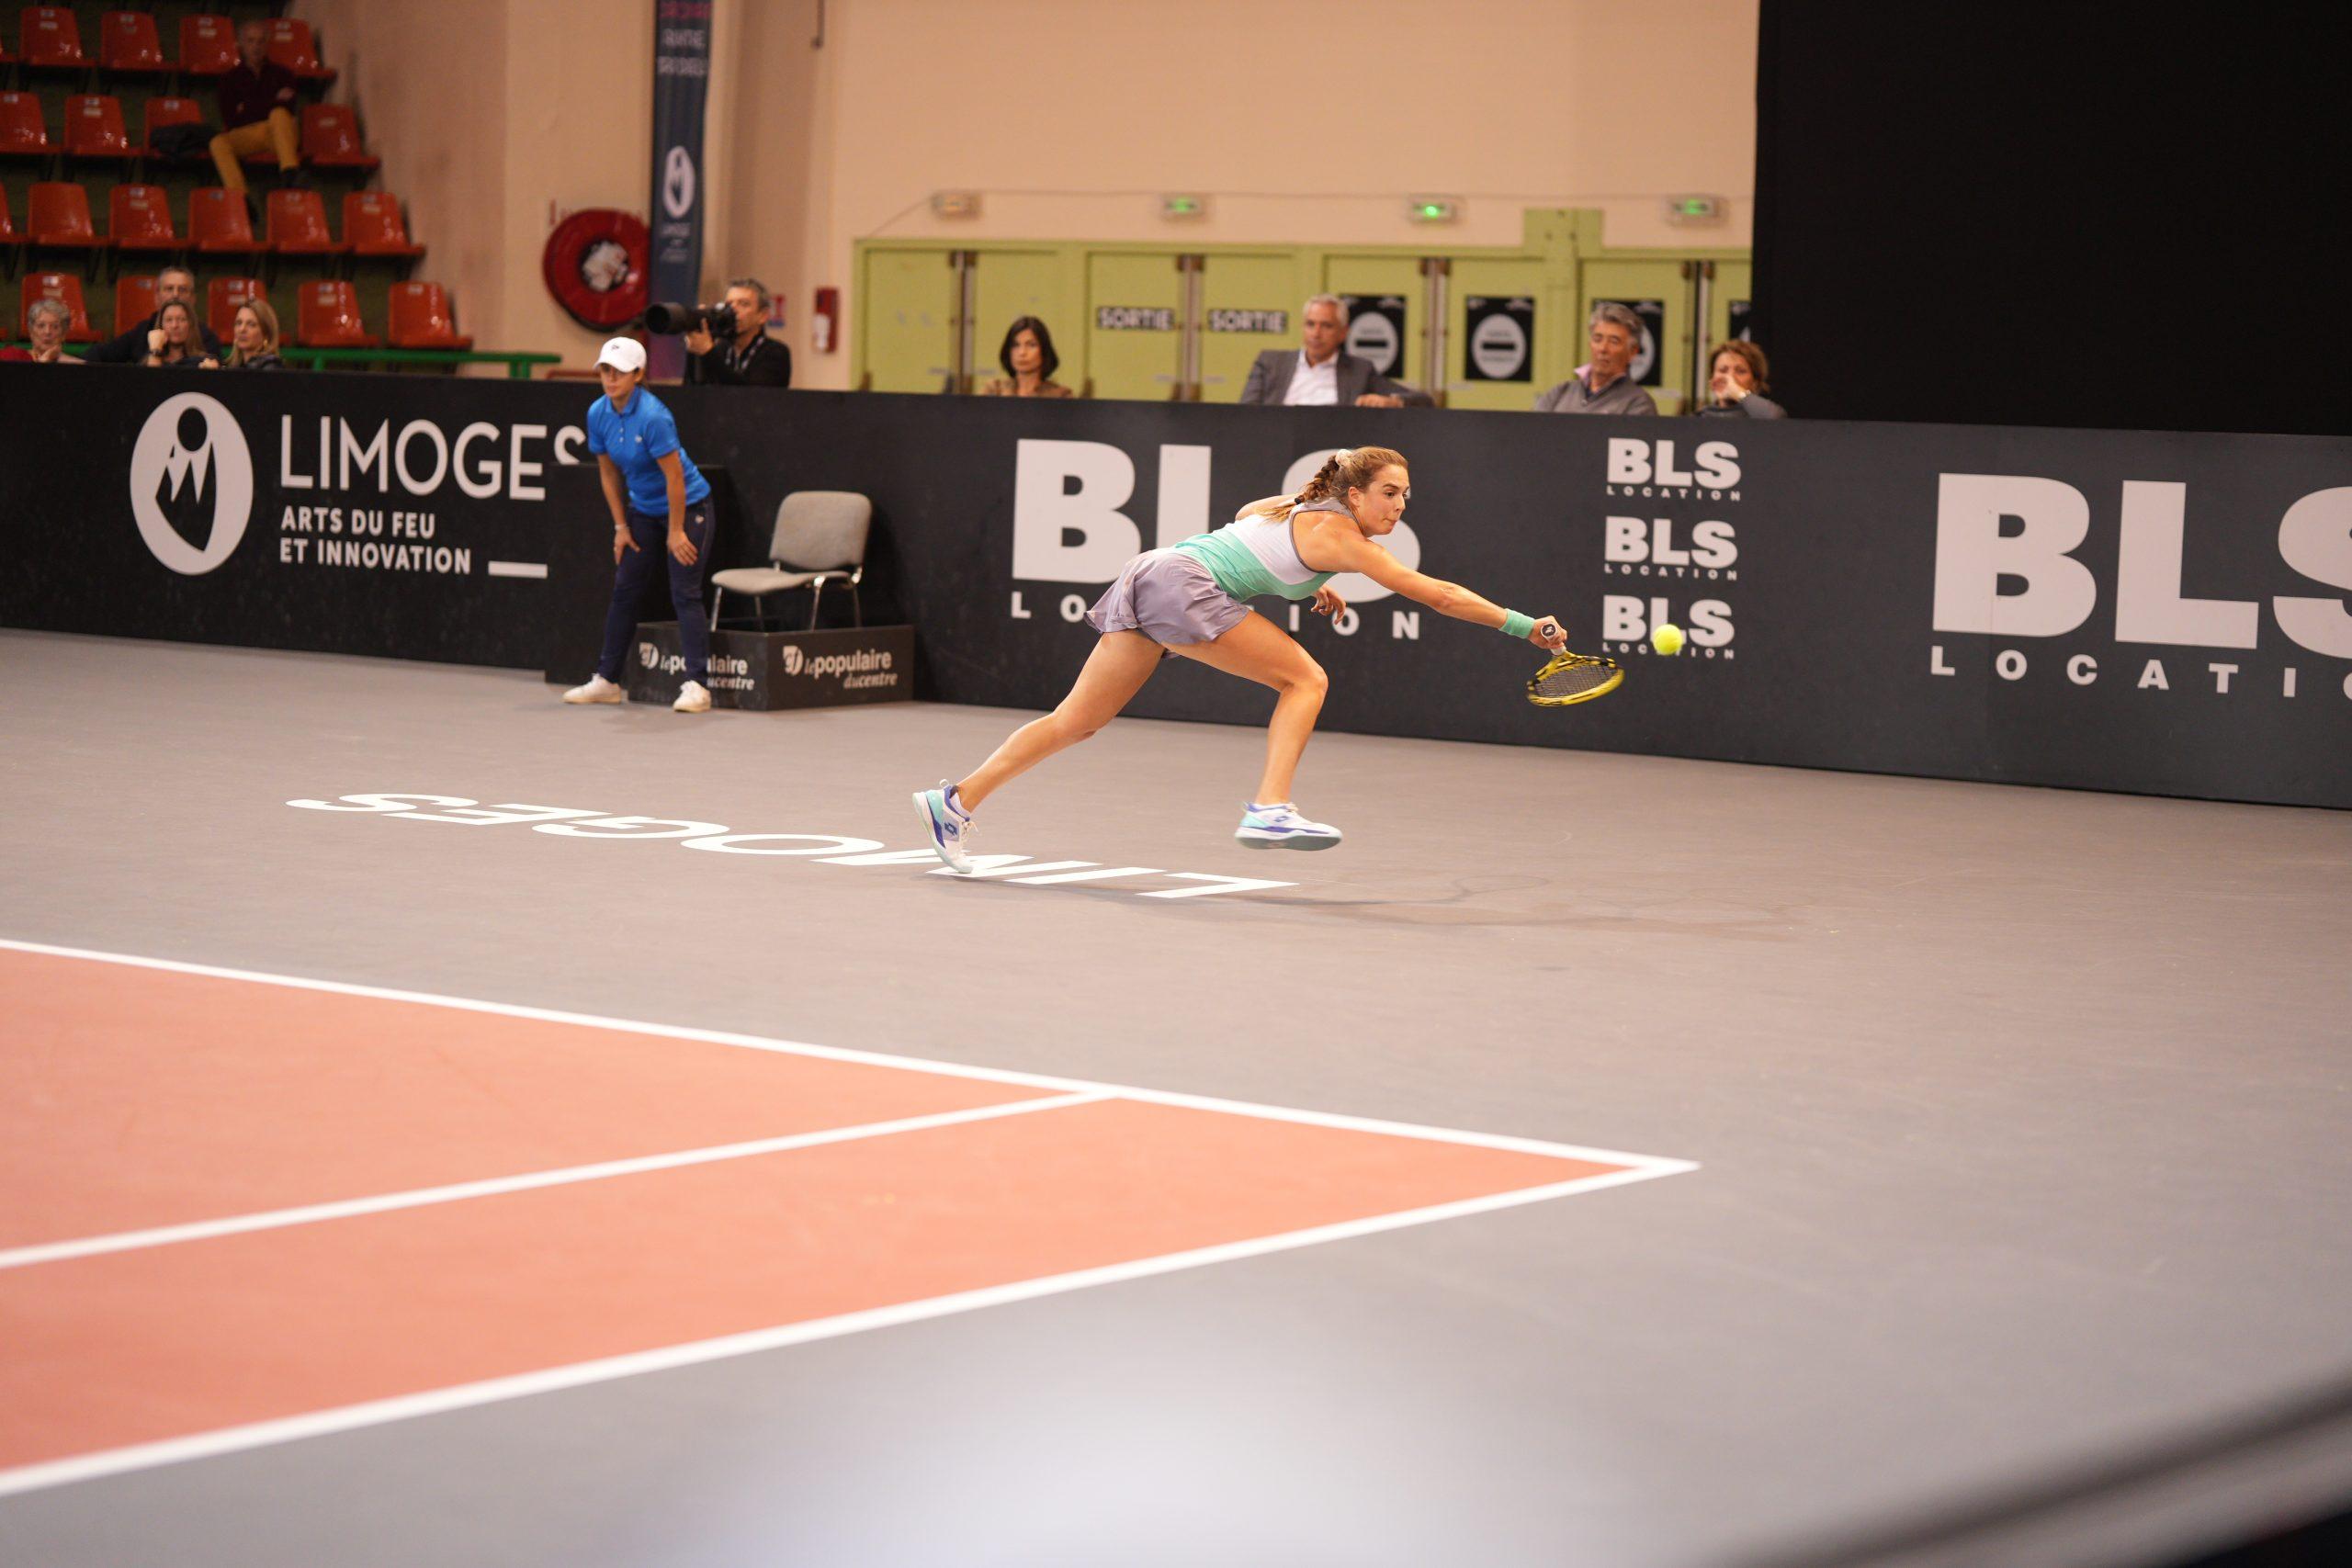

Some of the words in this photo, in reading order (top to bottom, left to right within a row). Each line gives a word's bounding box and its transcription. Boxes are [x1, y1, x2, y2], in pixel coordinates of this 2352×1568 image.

[1100, 307, 1172, 331] SORTIE
[1211, 310, 1286, 333] SORTIE
[1607, 437, 1742, 490] BLS
[1607, 485, 1741, 502] LOCATION
[281, 505, 343, 534] ARTS
[351, 509, 383, 536] DU
[392, 512, 435, 539] FEU
[1605, 515, 1738, 570] BLS
[279, 537, 309, 564] ET
[318, 540, 471, 575] INNOVATION
[1604, 563, 1737, 581] LOCATION
[1012, 592, 1419, 641] LOION
[1602, 642, 1735, 660] LOCION
[706, 676, 755, 691] ucentre
